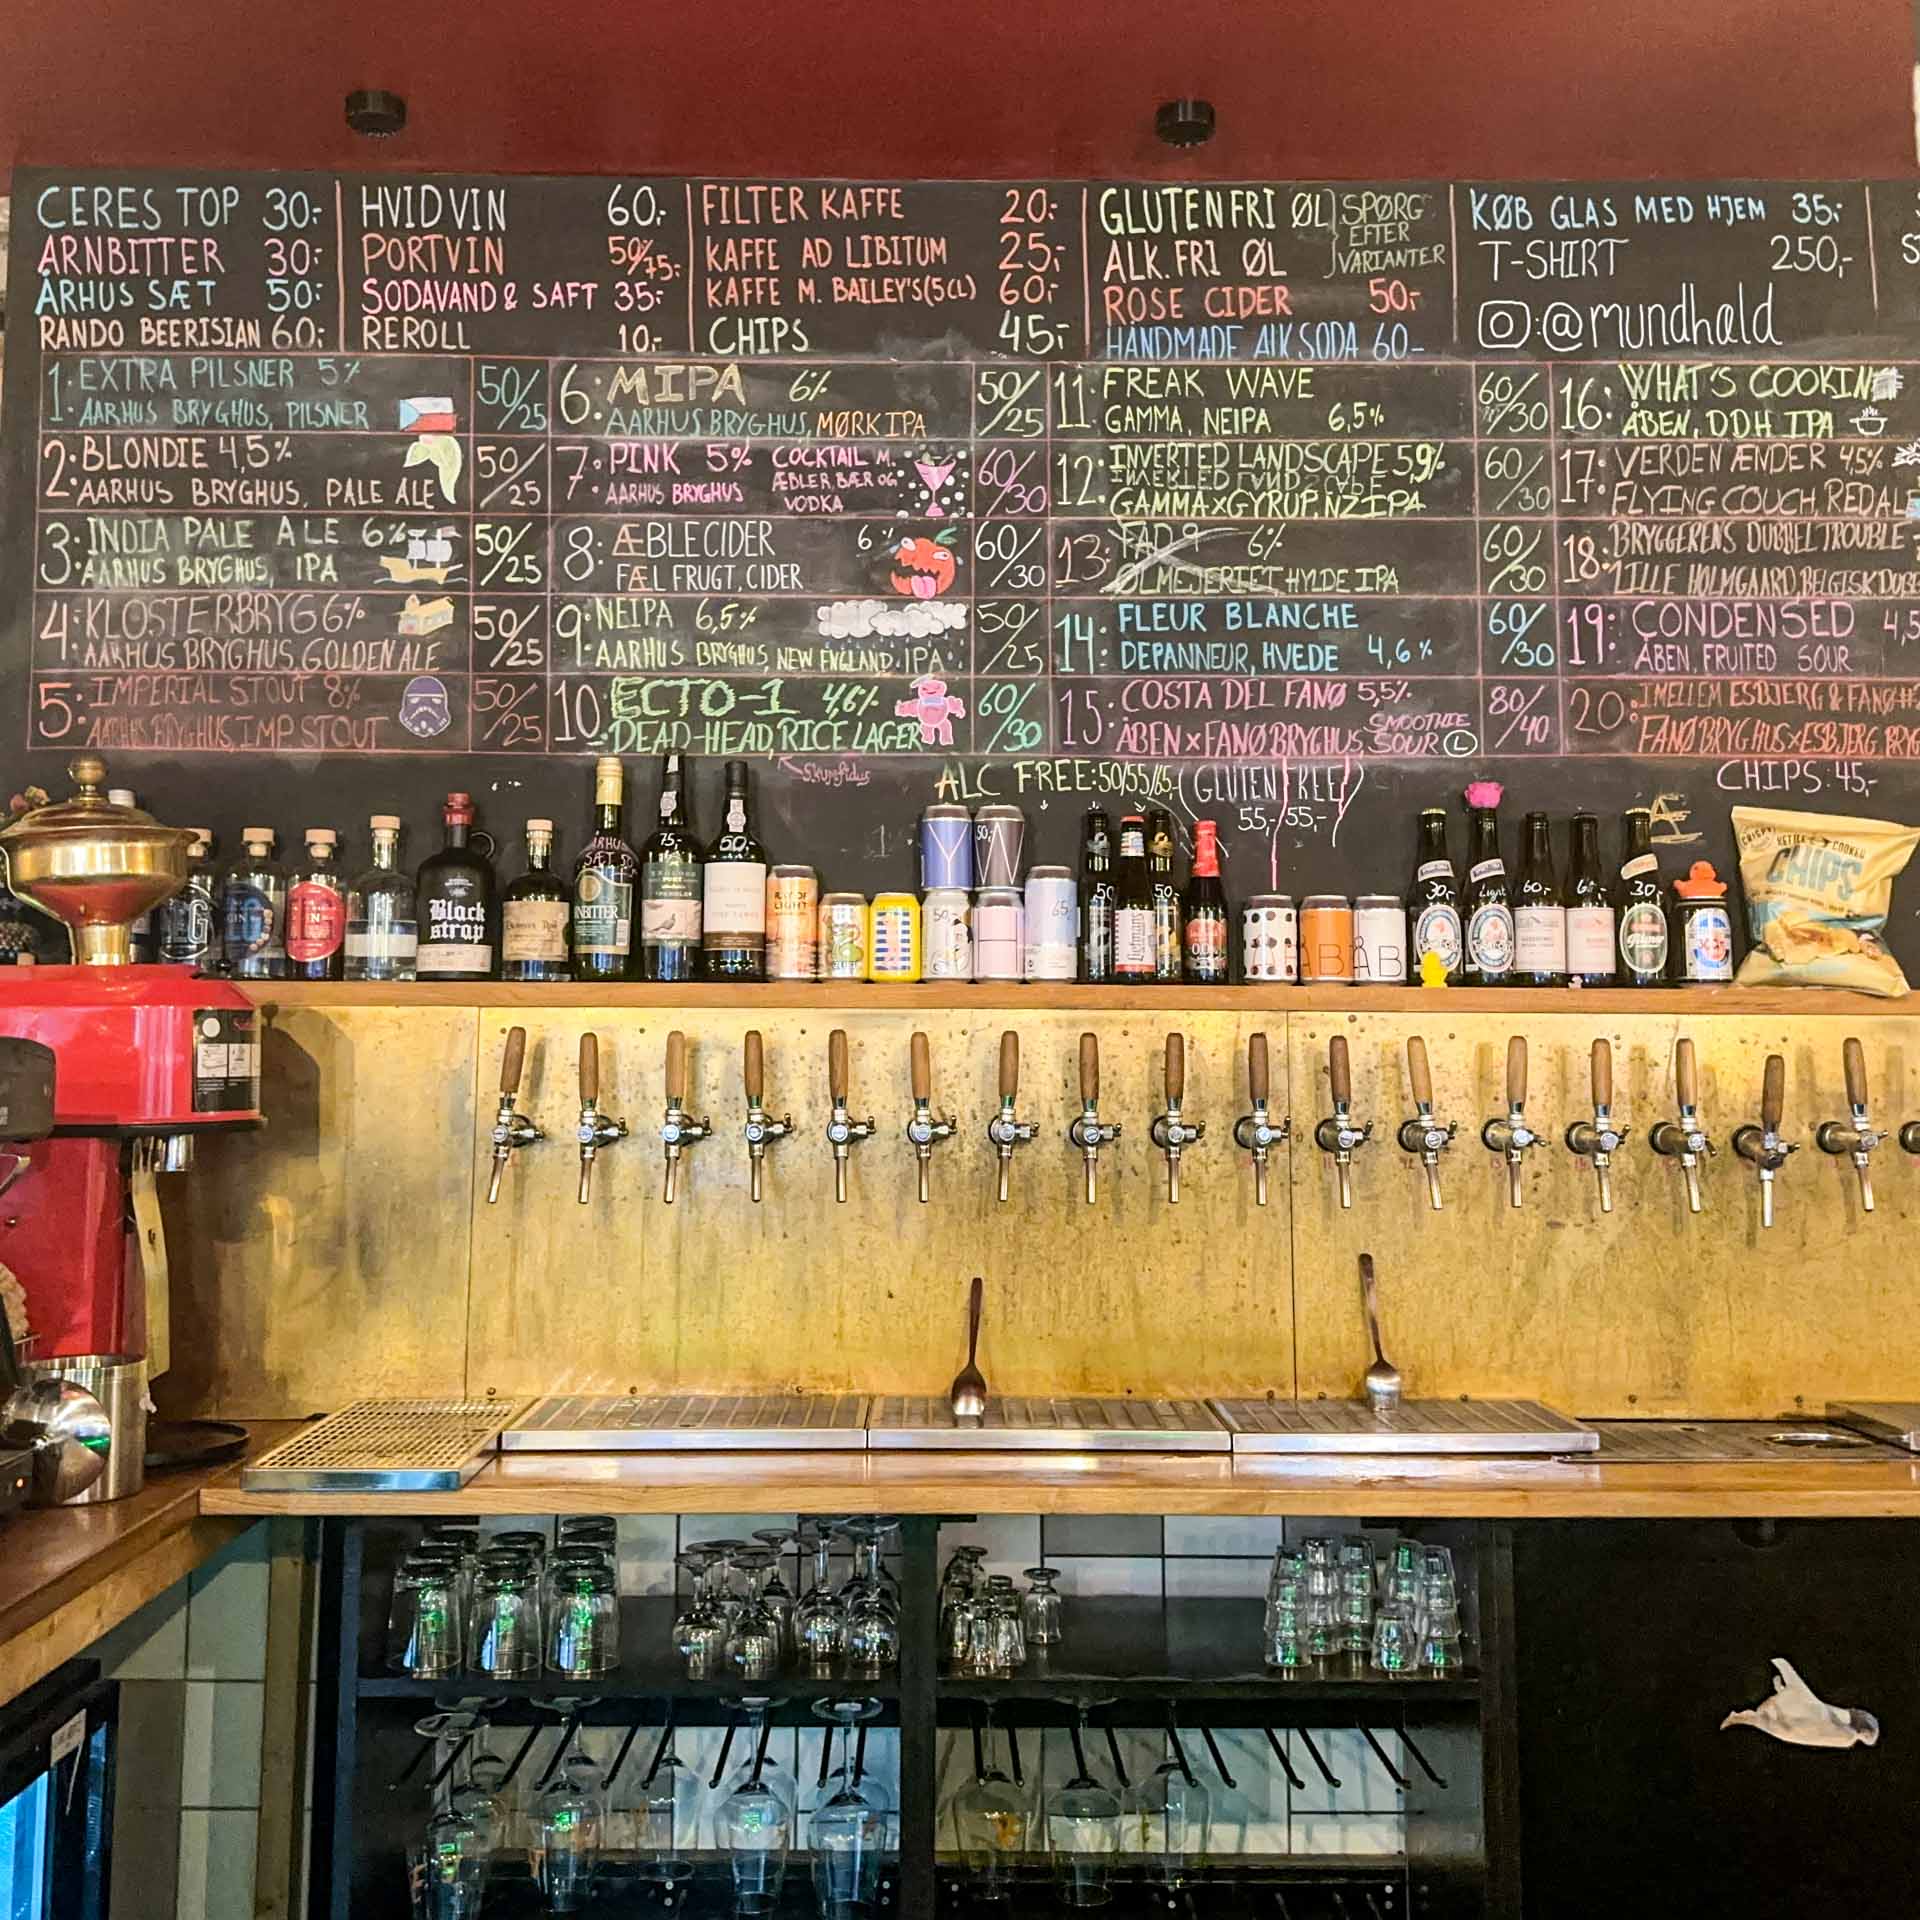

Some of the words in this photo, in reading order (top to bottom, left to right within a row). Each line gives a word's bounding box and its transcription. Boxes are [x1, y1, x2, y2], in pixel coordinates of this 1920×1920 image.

[37, 186, 161, 230] CERES
[176, 186, 240, 227] TOP
[703, 184, 809, 226] FILTER
[822, 188, 905, 221] KAFFE
[1292, 192, 1329, 229] ØL
[1470, 188, 1533, 231] KØB
[1551, 196, 1617, 230] GLAS
[1635, 197, 1694, 223] MED
[1708, 195, 1766, 222] HJEM
[1349, 221, 1411, 247] EFTER
[37, 235, 226, 277] ARNBITTER
[362, 233, 504, 276] PORTVIN
[705, 235, 780, 273] KAFFE
[802, 238, 833, 269] AD
[846, 235, 947, 269] LIBITUM
[1243, 238, 1287, 279] ØL
[1338, 244, 1446, 274] VARIANTER
[1478, 238, 1630, 282] T-SHIRT
[1770, 234, 1853, 279] 250,-
[34, 269, 134, 315] ÅRHUS
[148, 280, 216, 310] SÆT
[362, 278, 497, 315] SODAVAND
[504, 282, 517, 311] &
[532, 282, 598, 310] SAFT
[705, 276, 781, 308] KAFFE
[798, 277, 823, 305] M.
[1104, 287, 1184, 326] ROSE
[1205, 286, 1293, 319] CIDER
[40, 315, 124, 351] RANDO
[140, 317, 260, 348] BEERISIAN
[362, 316, 471, 350] REROLL
[709, 316, 809, 355] CHIPS
[79, 358, 177, 393] EXTRA
[191, 357, 294, 390] PILSNER
[607, 363, 746, 406] MIPA
[1103, 367, 1204, 399] FREAK
[1226, 367, 1314, 399] WAVE
[79, 397, 158, 428] AARHUS
[288, 400, 369, 430] PILSNER
[604, 407, 702, 437] AARHUS
[816, 411, 879, 437] MØRK
[885, 411, 927, 437] IPA
[1105, 405, 1192, 437] GAMMA,
[1204, 406, 1272, 436] NEIPA
[1783, 410, 1834, 438] IPA
[83, 435, 209, 472] BLONDIE
[609, 443, 681, 475] PINK
[771, 445, 869, 469] COCKTAIL
[1110, 442, 1230, 471] INVERTED
[1238, 443, 1392, 476] LANDSCAPE
[1615, 444, 1724, 478] VERDEN
[1730, 444, 1826, 474] ÆNDER
[76, 477, 175, 508] AARHUS
[192, 477, 309, 509] BRYGHUS,
[326, 478, 383, 508] PALE
[395, 477, 435, 509] ALE
[605, 482, 665, 505] AARHUS
[672, 483, 744, 505] BRYGHUS
[784, 494, 844, 513] VODKA
[1612, 480, 1717, 517] FLYING
[86, 516, 170, 556] INDIA
[182, 516, 254, 549] PALE
[277, 515, 340, 546] ALE
[81, 556, 167, 587] AARHUS
[296, 553, 338, 583] IPA
[617, 563, 666, 592] FÆL
[746, 563, 804, 591] CIDER
[1612, 561, 1681, 594] LILLE
[596, 598, 673, 631] NEIPA
[1119, 602, 1207, 633] FLEUR
[1226, 602, 1359, 630] BLANCHE
[1632, 601, 1855, 639] CONDENSED
[85, 640, 176, 670] AARHUS
[302, 640, 396, 672] GOLDEN
[400, 640, 442, 672] ALE
[596, 637, 684, 669] AARHUS
[777, 647, 812, 671] NEW
[904, 648, 945, 672] IPA
[1263, 641, 1339, 673] HVEDE
[1704, 645, 1777, 672] FRUITED
[1799, 645, 1853, 673] SOUR
[89, 675, 221, 708] IMPERIAL
[230, 675, 311, 706] STOUT
[610, 677, 800, 720] ECTO-1
[1122, 679, 1212, 712] COSTA
[1225, 678, 1275, 710] DEL
[1284, 680, 1347, 711] FANØ
[302, 714, 389, 749] STOUT
[777, 720, 849, 750] RICE
[852, 720, 923, 752] LAGER
[1369, 732, 1439, 755] SOUR
[935, 762, 1000, 800] ALC
[429, 899, 486, 922] Black
[429, 921, 484, 944] strap
